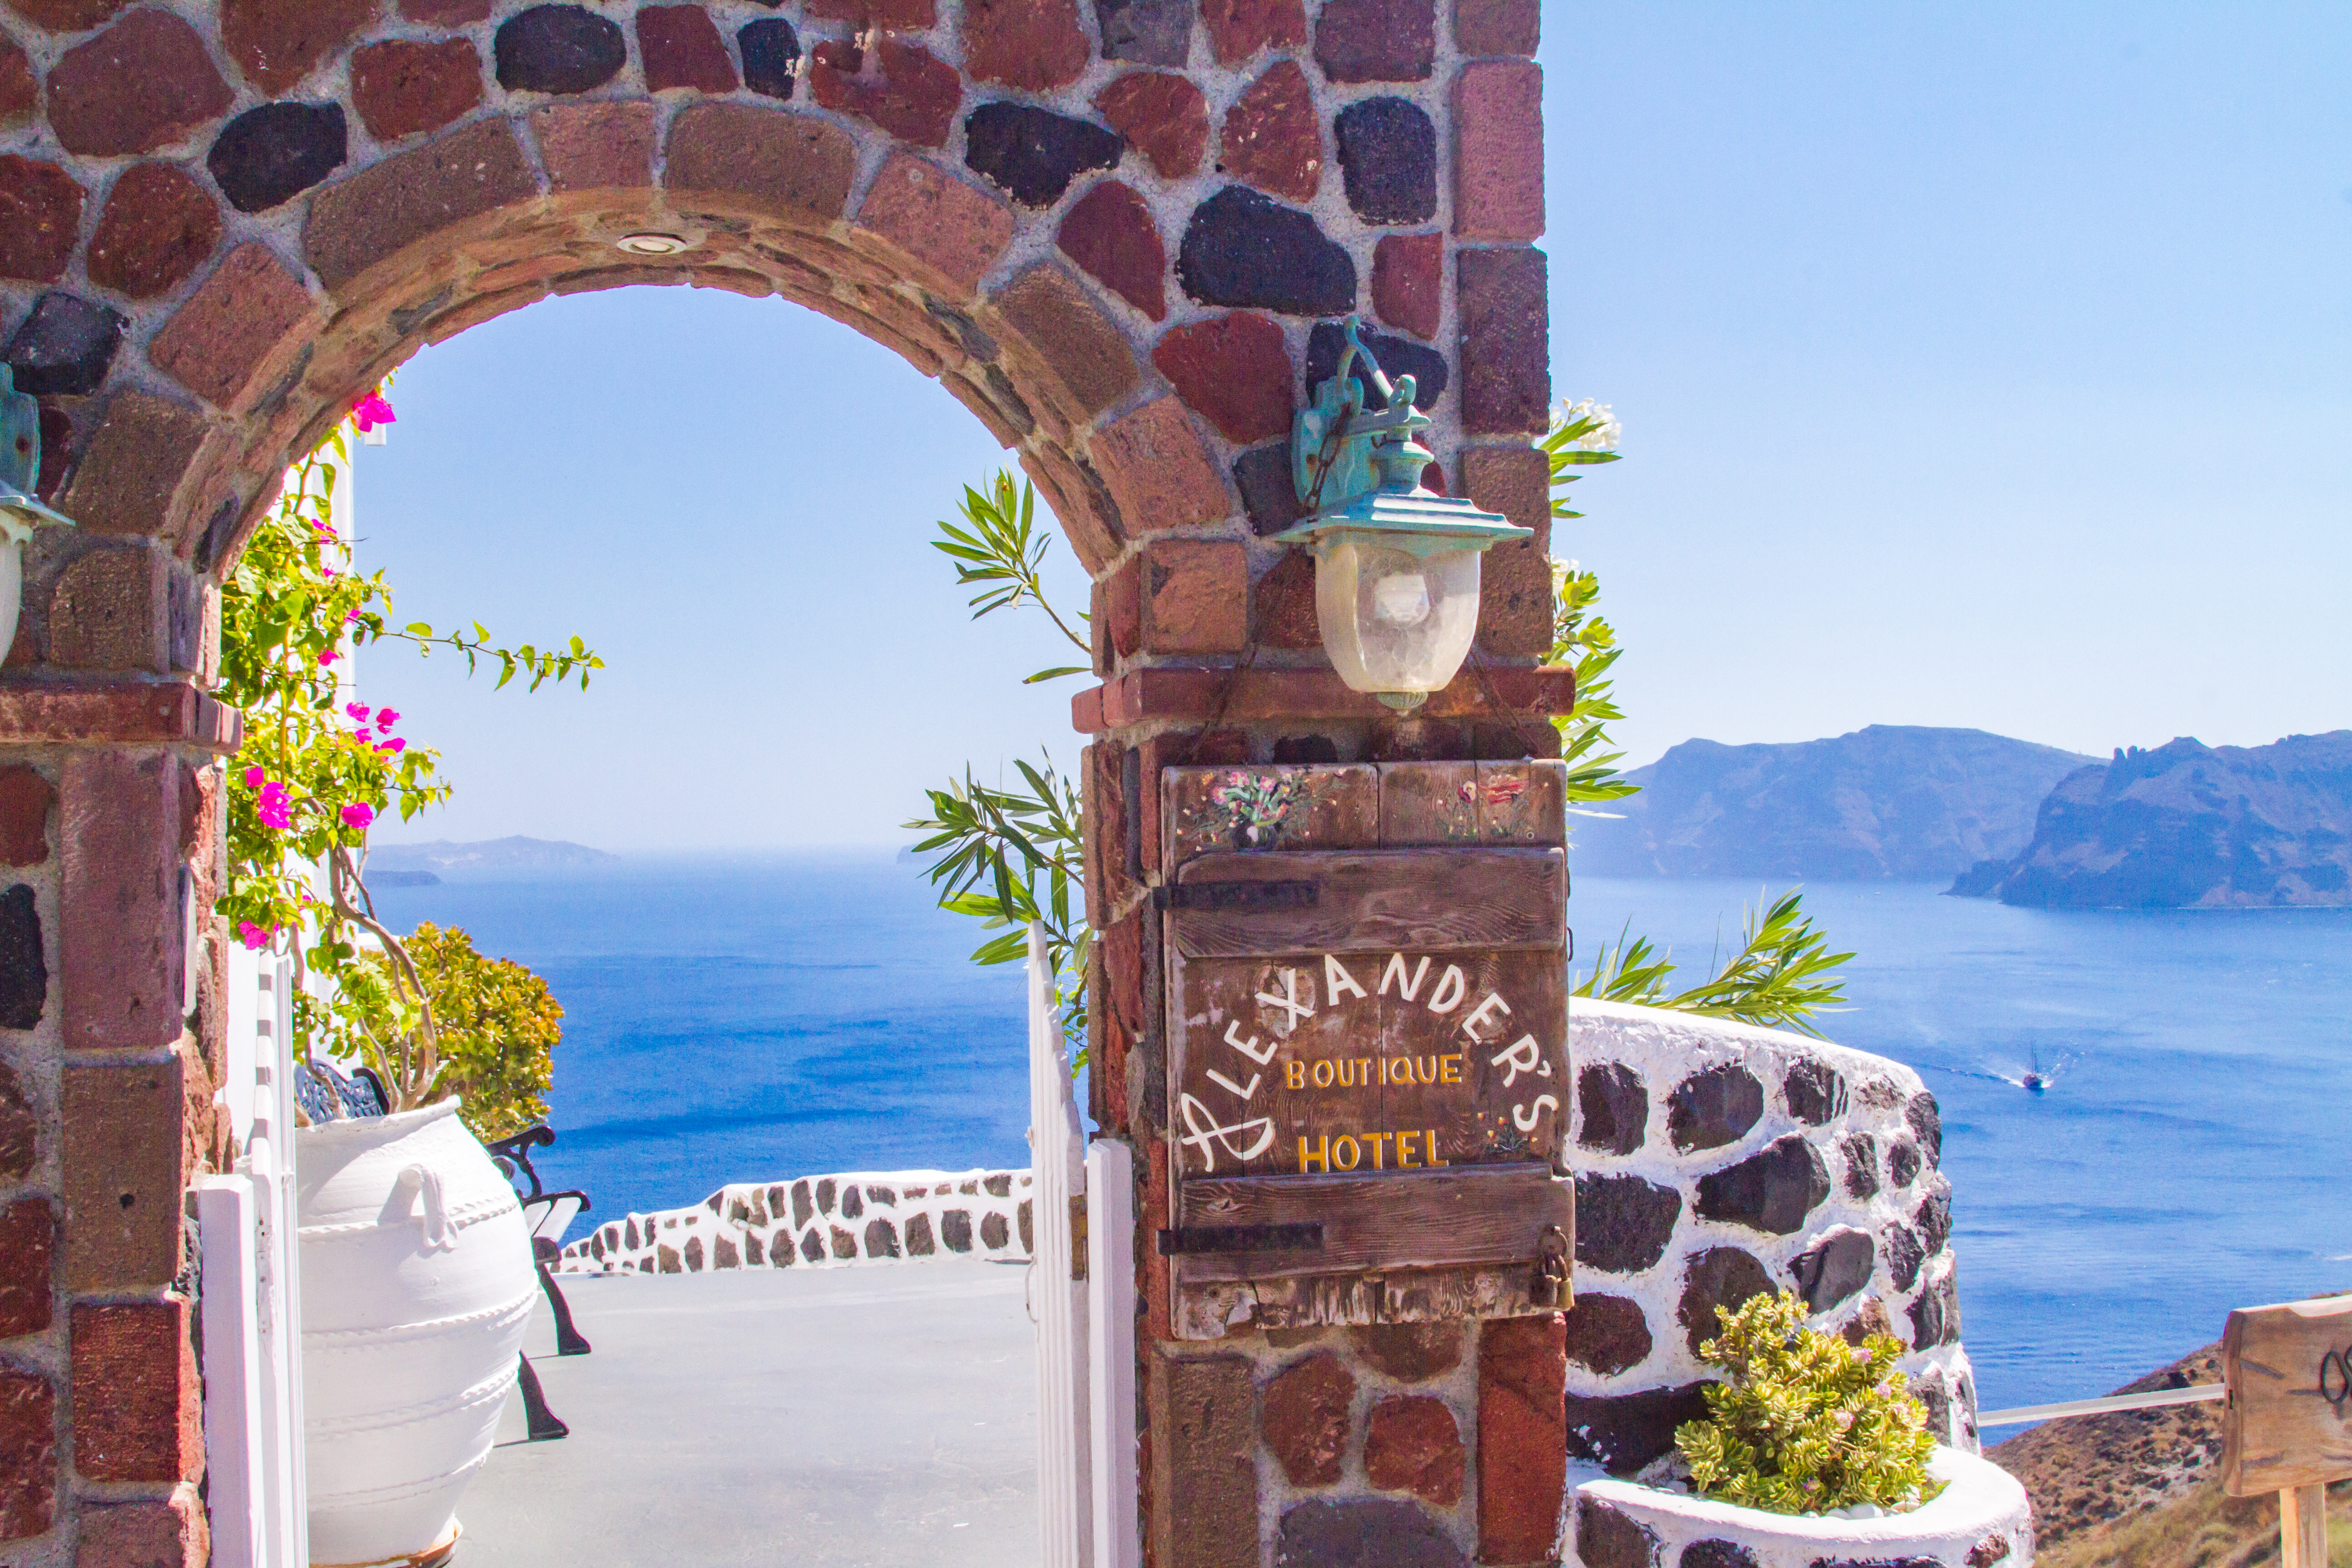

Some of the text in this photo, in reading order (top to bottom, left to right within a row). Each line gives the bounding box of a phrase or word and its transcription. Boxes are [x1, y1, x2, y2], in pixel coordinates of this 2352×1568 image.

[1181, 952, 1558, 1171] ALEXANDER'S
[1286, 1054, 1462, 1089] BOUTIQUE
[1298, 1129, 1449, 1173] HOTEL
